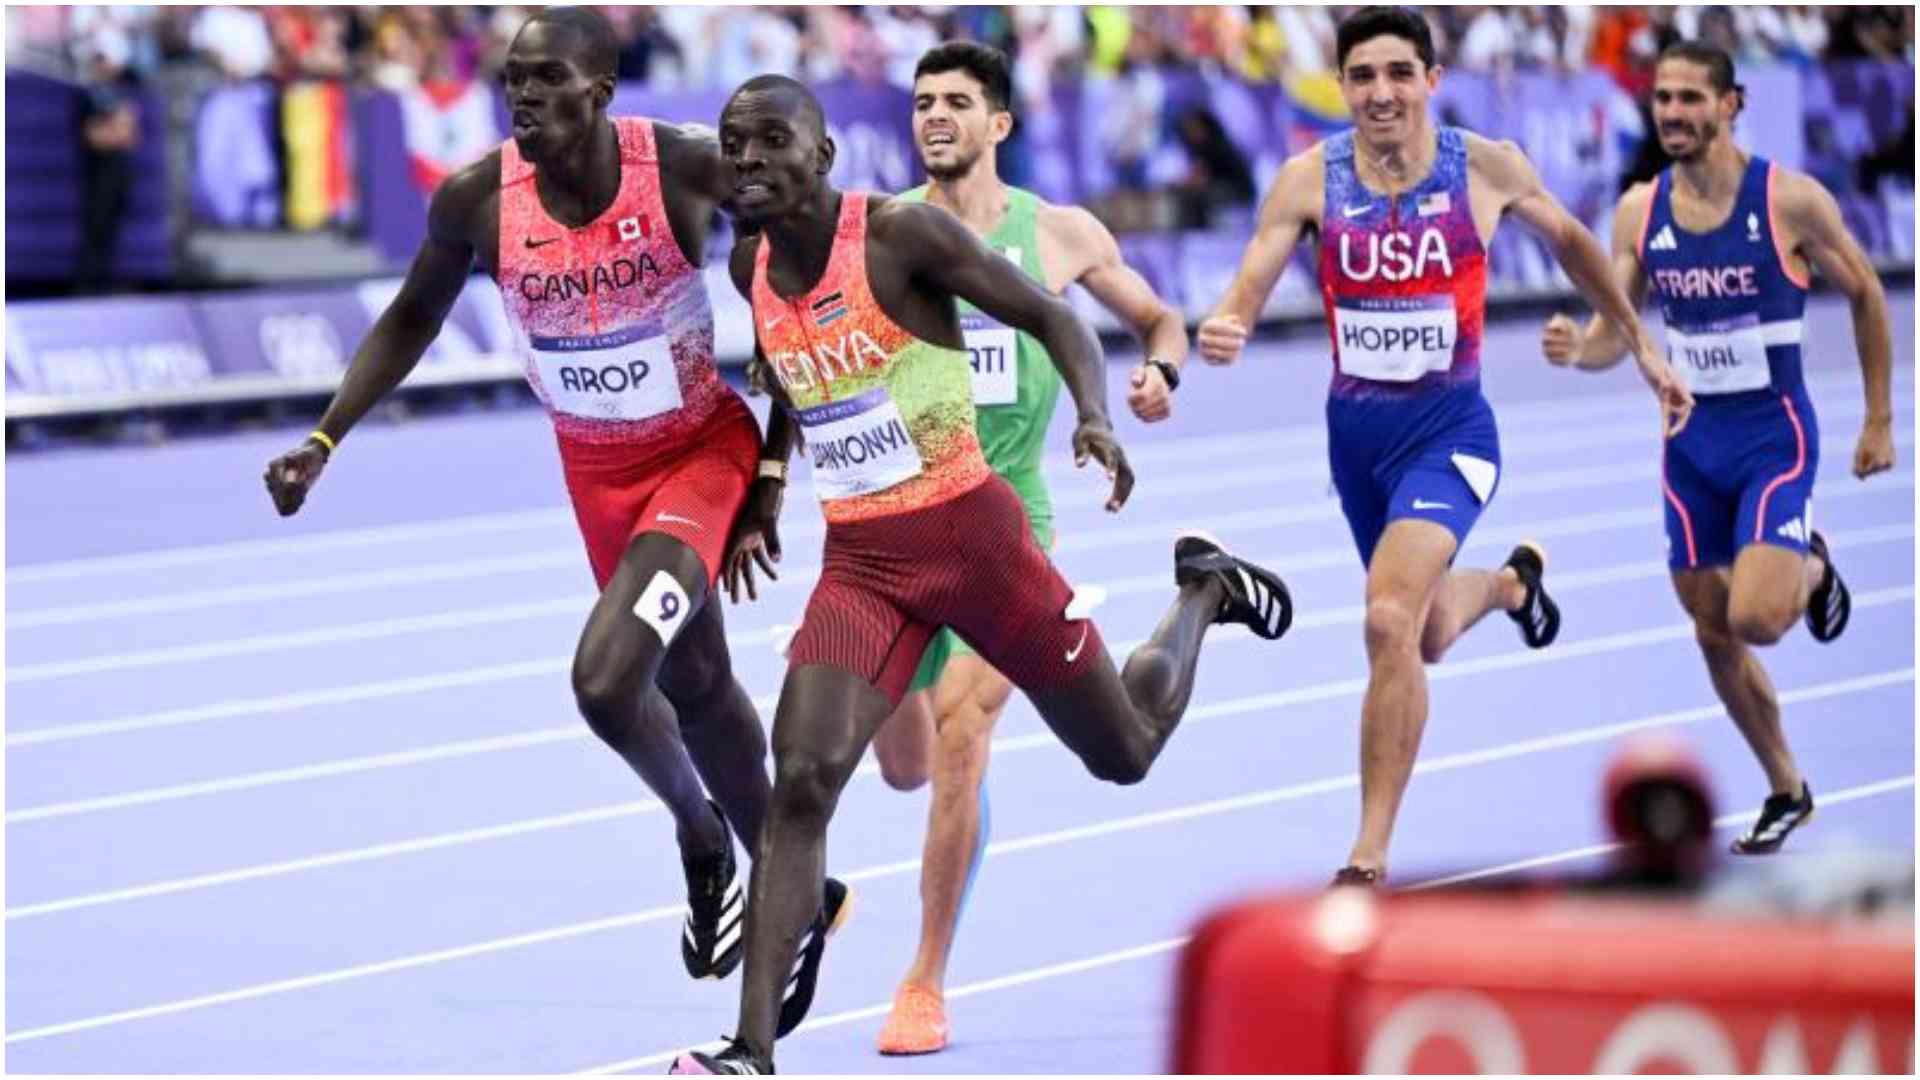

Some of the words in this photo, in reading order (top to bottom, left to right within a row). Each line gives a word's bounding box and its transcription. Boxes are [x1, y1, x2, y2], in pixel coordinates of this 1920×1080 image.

[1340, 227, 1453, 281] USA
[520, 252, 661, 301] CANADA
[1655, 266, 1759, 298] FRANCE
[1343, 324, 1449, 351] HOPPEL
[559, 360, 649, 393] AROP
[775, 329, 889, 391] KENYA
[658, 591, 680, 622] 9
